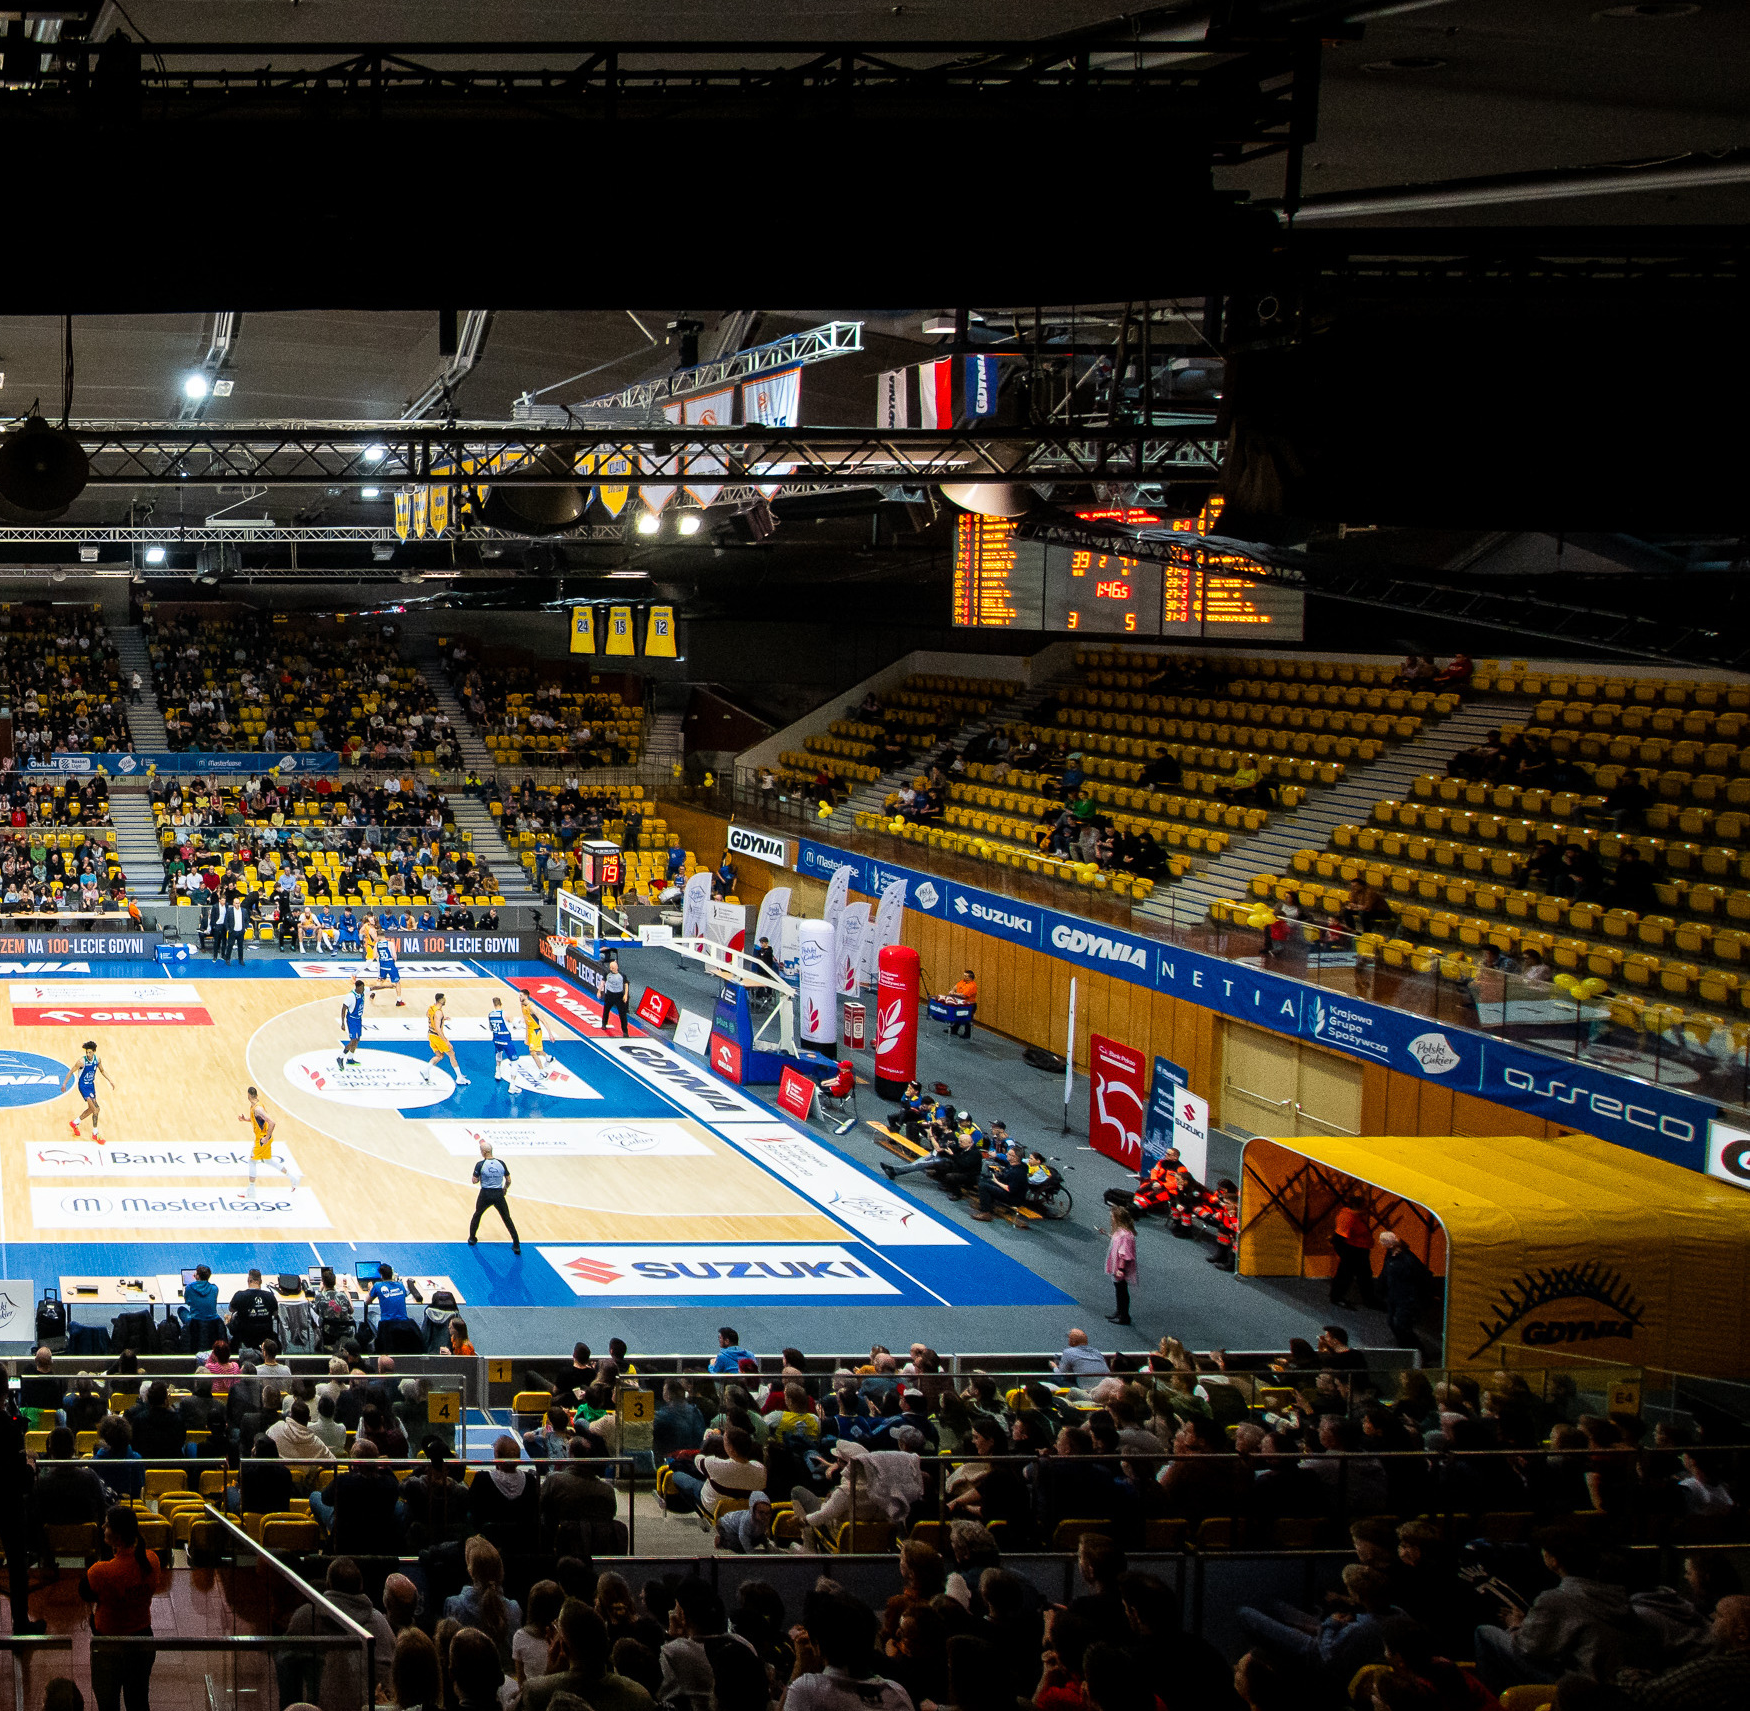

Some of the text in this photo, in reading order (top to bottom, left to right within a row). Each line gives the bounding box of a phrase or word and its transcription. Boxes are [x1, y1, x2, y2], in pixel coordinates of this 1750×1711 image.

[1173, 520, 1205, 531] 8-0 0
[1072, 552, 1107, 568] 39 2
[1166, 578, 1203, 587] 23-2 2
[1165, 590, 1189, 599] 27-2
[1165, 601, 1188, 610] 30-2
[1068, 612, 1136, 631] 3 5
[1165, 612, 1202, 622] 31-0 4
[577, 619, 589, 634] 24
[614, 619, 626, 635] 15
[655, 619, 668, 635] 12
[730, 830, 782, 858] GDYNIA
[603, 855, 618, 865] 1:46
[602, 866, 619, 883] 19
[569, 902, 592, 921] SUZUKI
[970, 903, 1032, 934] SUZUKI
[27, 938, 45, 954] NA
[47, 938, 106, 954] 100-LECIE
[108, 938, 144, 954] GDYNI
[403, 937, 520, 953] NA 100-LECIE GDYNI
[1051, 924, 1147, 970] GDYNIA
[566, 955, 596, 987] 100-LECIE
[91, 1012, 185, 1021] ORLEN
[1329, 1004, 1373, 1026] Krajowa
[1329, 1016, 1364, 1037] Grupa
[1328, 1027, 1389, 1054] Spożywcza
[1415, 1039, 1447, 1056] Polski
[1421, 1052, 1455, 1068] Cukier
[331, 1073, 387, 1081] Grupa
[618, 1045, 747, 1112] GDYNIA
[1503, 1066, 1696, 1143] asseco
[1174, 1117, 1205, 1140] SUZUKI
[111, 1151, 285, 1165] Bank Peko
[121, 1197, 292, 1213] Masterlease
[630, 1261, 871, 1279] SUZUKI
[1521, 1318, 1634, 1345] GDYNIA
[496, 1367, 503, 1379] 1
[1615, 1393, 1632, 1404] E4
[438, 1403, 450, 1419] 4
[633, 1403, 644, 1417] 3
